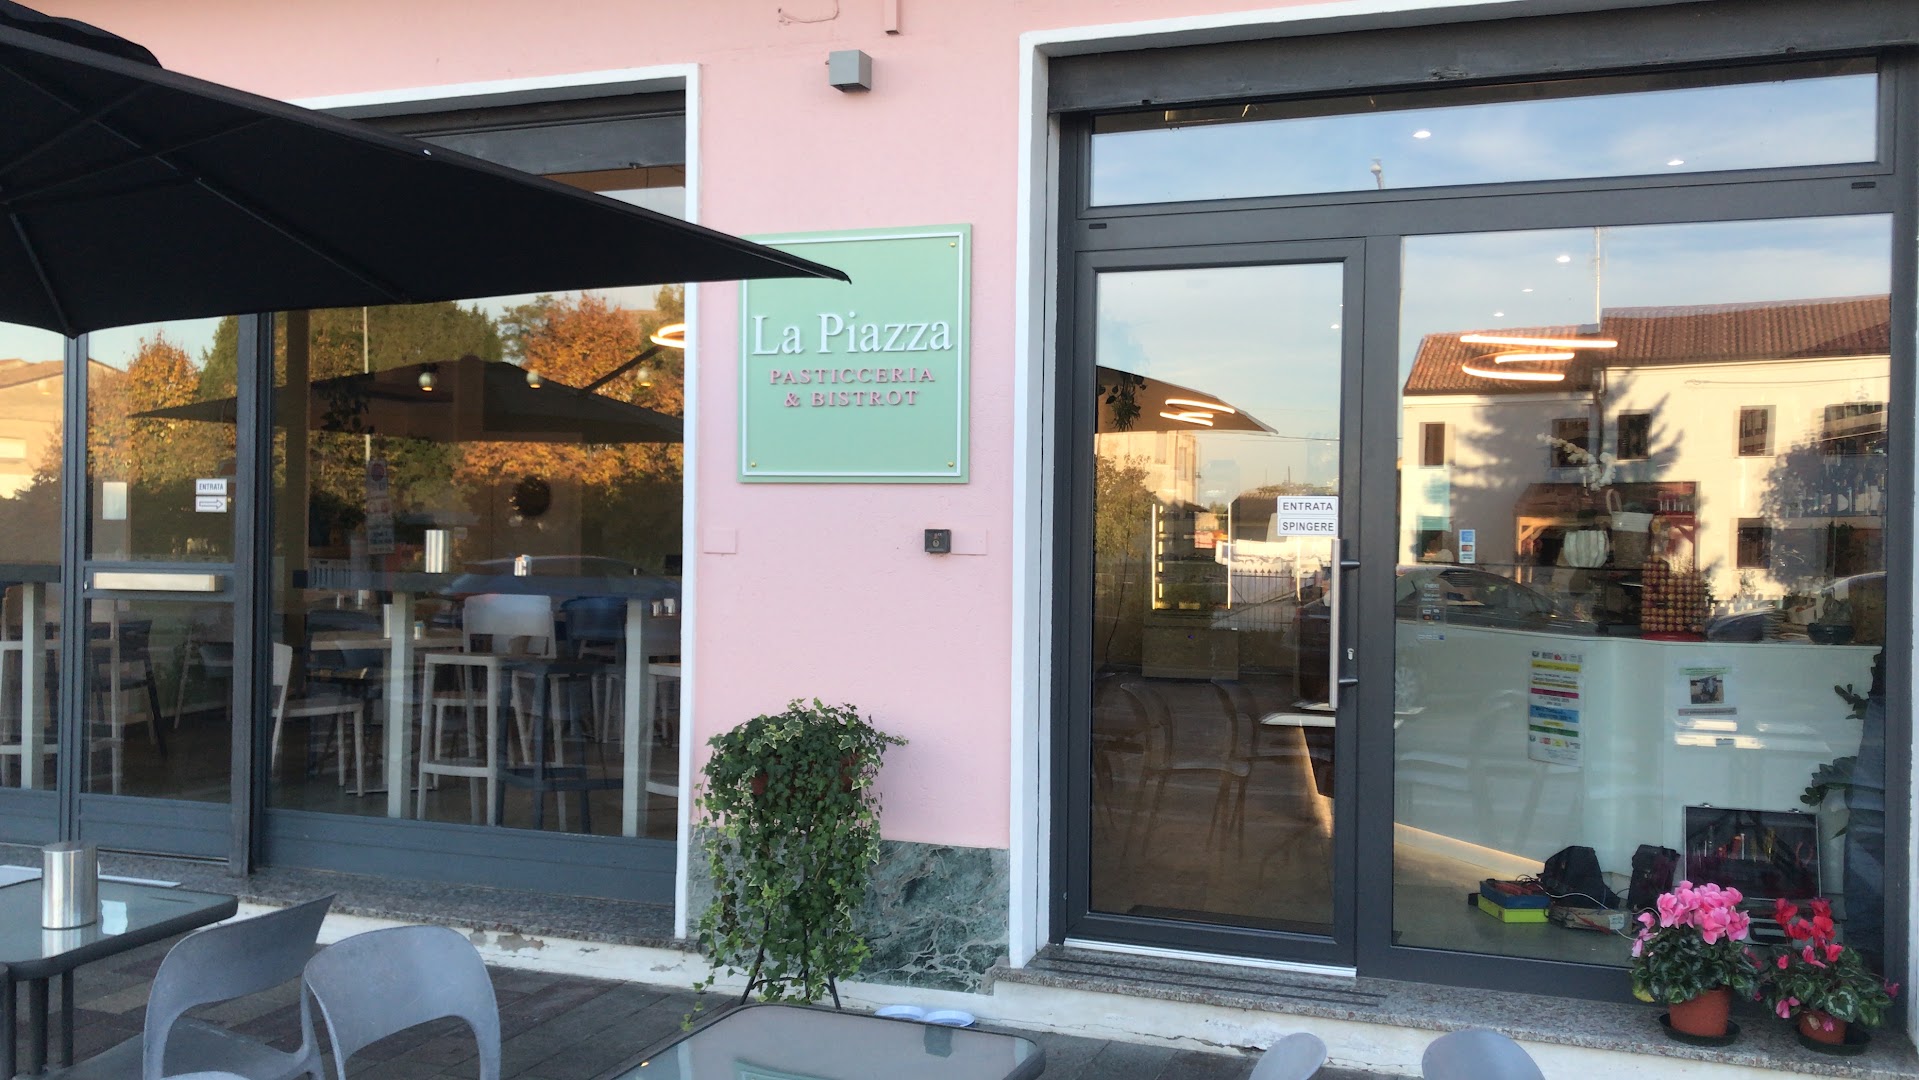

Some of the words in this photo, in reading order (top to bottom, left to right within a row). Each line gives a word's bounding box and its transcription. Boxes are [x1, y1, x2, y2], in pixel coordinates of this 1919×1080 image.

[752, 315, 804, 355] La
[817, 311, 953, 354] Piazza
[769, 367, 935, 385] PASTICCERIA
[784, 393, 801, 407] &
[811, 390, 918, 407] BISTROT
[1282, 502, 1333, 510] ENTRATA
[1282, 522, 1334, 531] SPINGERE
